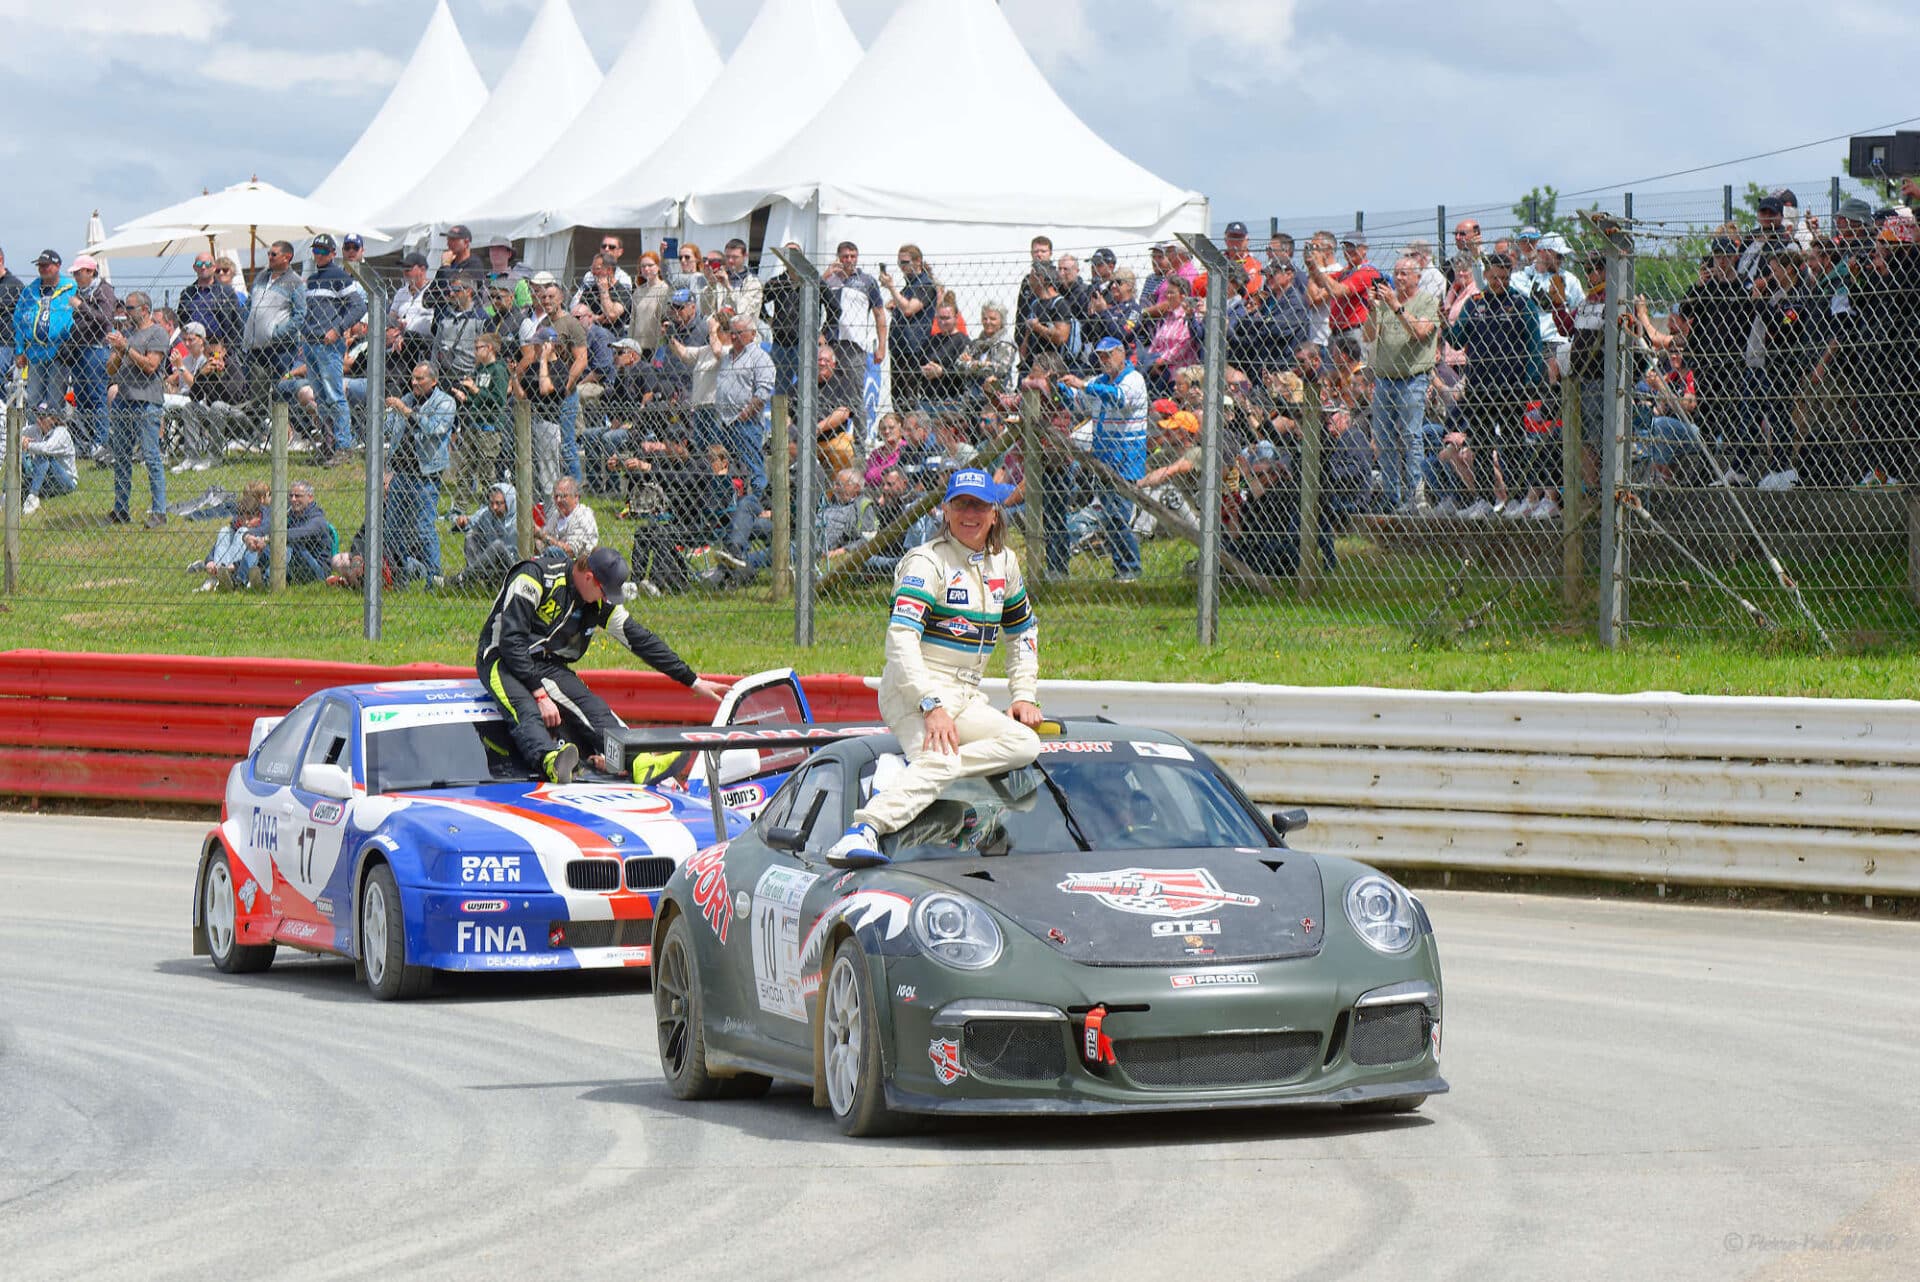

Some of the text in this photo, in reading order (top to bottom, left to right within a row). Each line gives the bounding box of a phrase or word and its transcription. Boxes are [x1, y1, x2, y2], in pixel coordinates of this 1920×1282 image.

[249, 807, 279, 852] FINA
[297, 826, 316, 885] 17
[462, 856, 520, 868] DAF
[462, 868, 520, 882] CAEN
[457, 921, 527, 953] FINA
[1153, 919, 1220, 936] GT2i
[761, 906, 777, 982] 10
